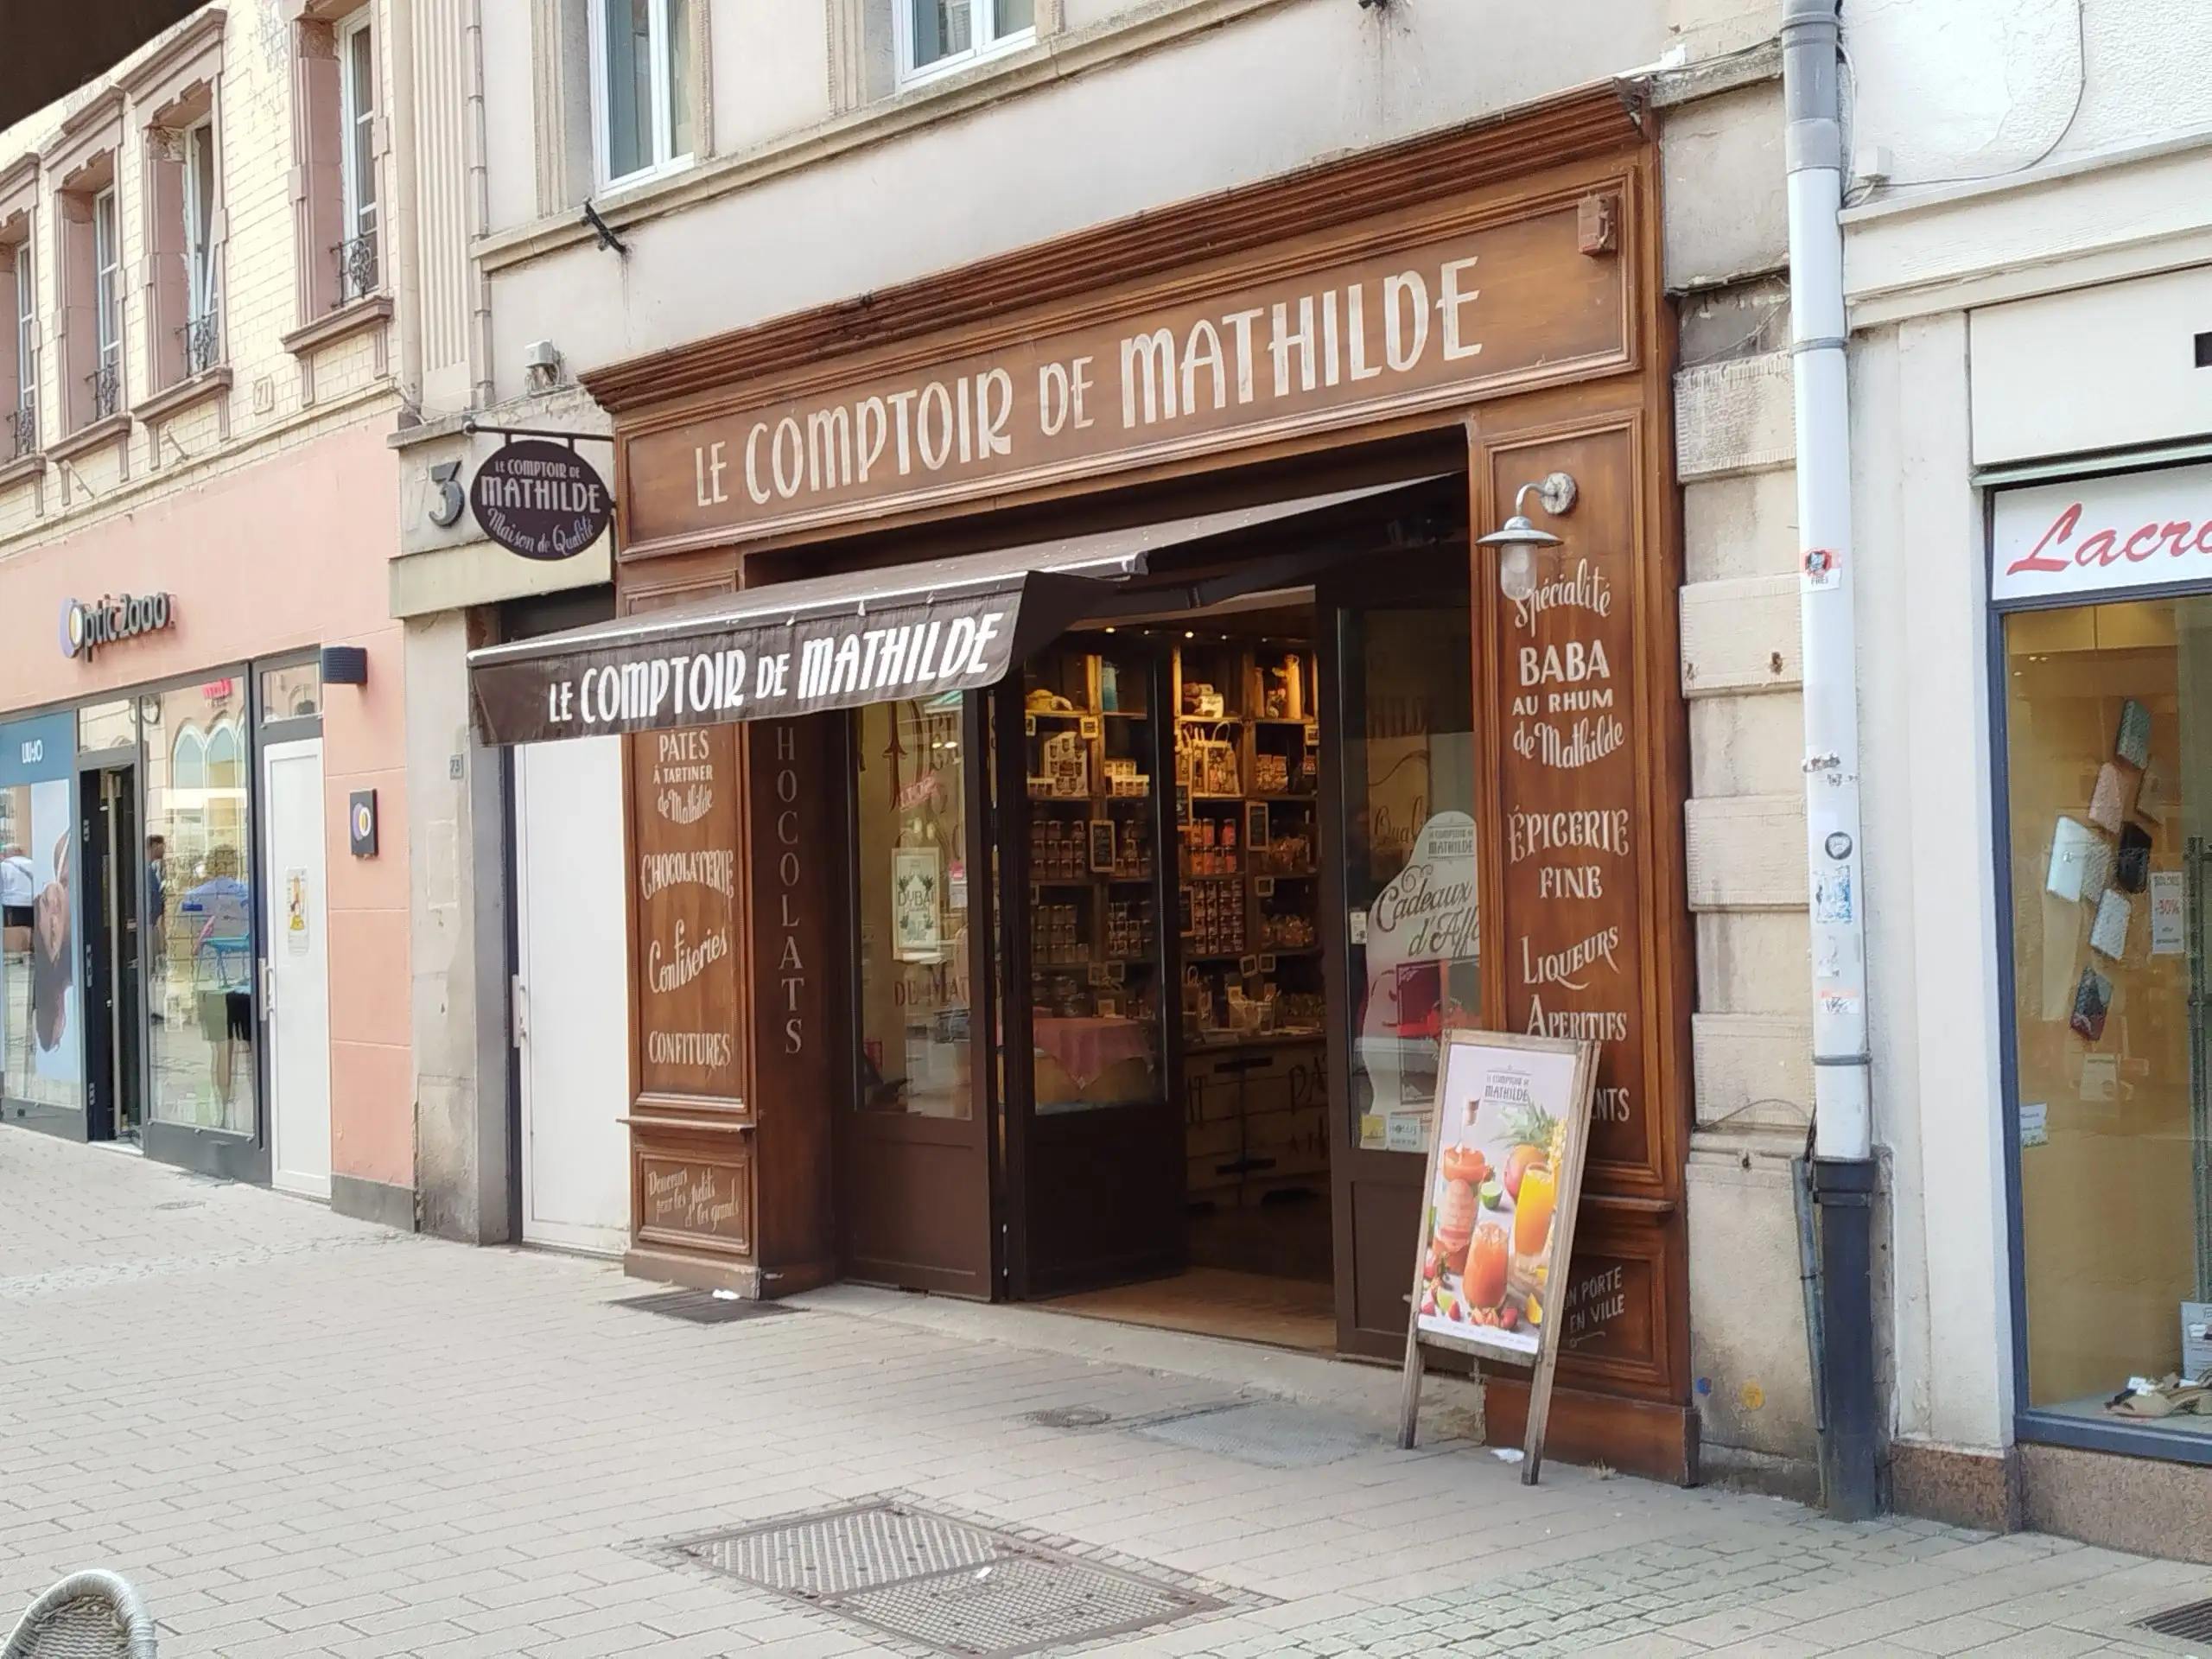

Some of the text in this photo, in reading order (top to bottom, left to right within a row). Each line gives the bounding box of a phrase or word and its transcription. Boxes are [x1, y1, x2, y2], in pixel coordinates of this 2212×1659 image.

[695, 255, 1483, 507] LE COMPTOIR DE MATHILDE
[495, 459, 581, 479] LE COMPTOIR DE
[480, 475, 601, 514] MATHILDE
[487, 507, 594, 556] Maison de Qualité
[1514, 557, 1611, 638] Spécialité
[550, 612, 1004, 723] LE COMPTOIR DE MATHILDE
[1520, 639, 1611, 687] BABA
[1511, 688, 1614, 716] AU RHUM
[1513, 714, 1625, 769] de Mathilde
[664, 764, 713, 784] TARTINER
[1508, 804, 1630, 865] ÉPICERIE
[640, 849, 734, 900] CHOCOLATERIE
[776, 727, 804, 1054] HOCOLATS
[1376, 864, 1473, 933] Cadeaux
[1539, 865, 1603, 899] FINE
[649, 918, 728, 994] Confiseries
[1521, 925, 1620, 991] LIQUEURS
[1527, 994, 1628, 1041] APERITIFS
[649, 1030, 732, 1067] CONFITURES
[1592, 1086, 1630, 1122] NTS
[1581, 1265, 1623, 1303] PORTE
[1569, 1293, 1625, 1334] EN VILLE
